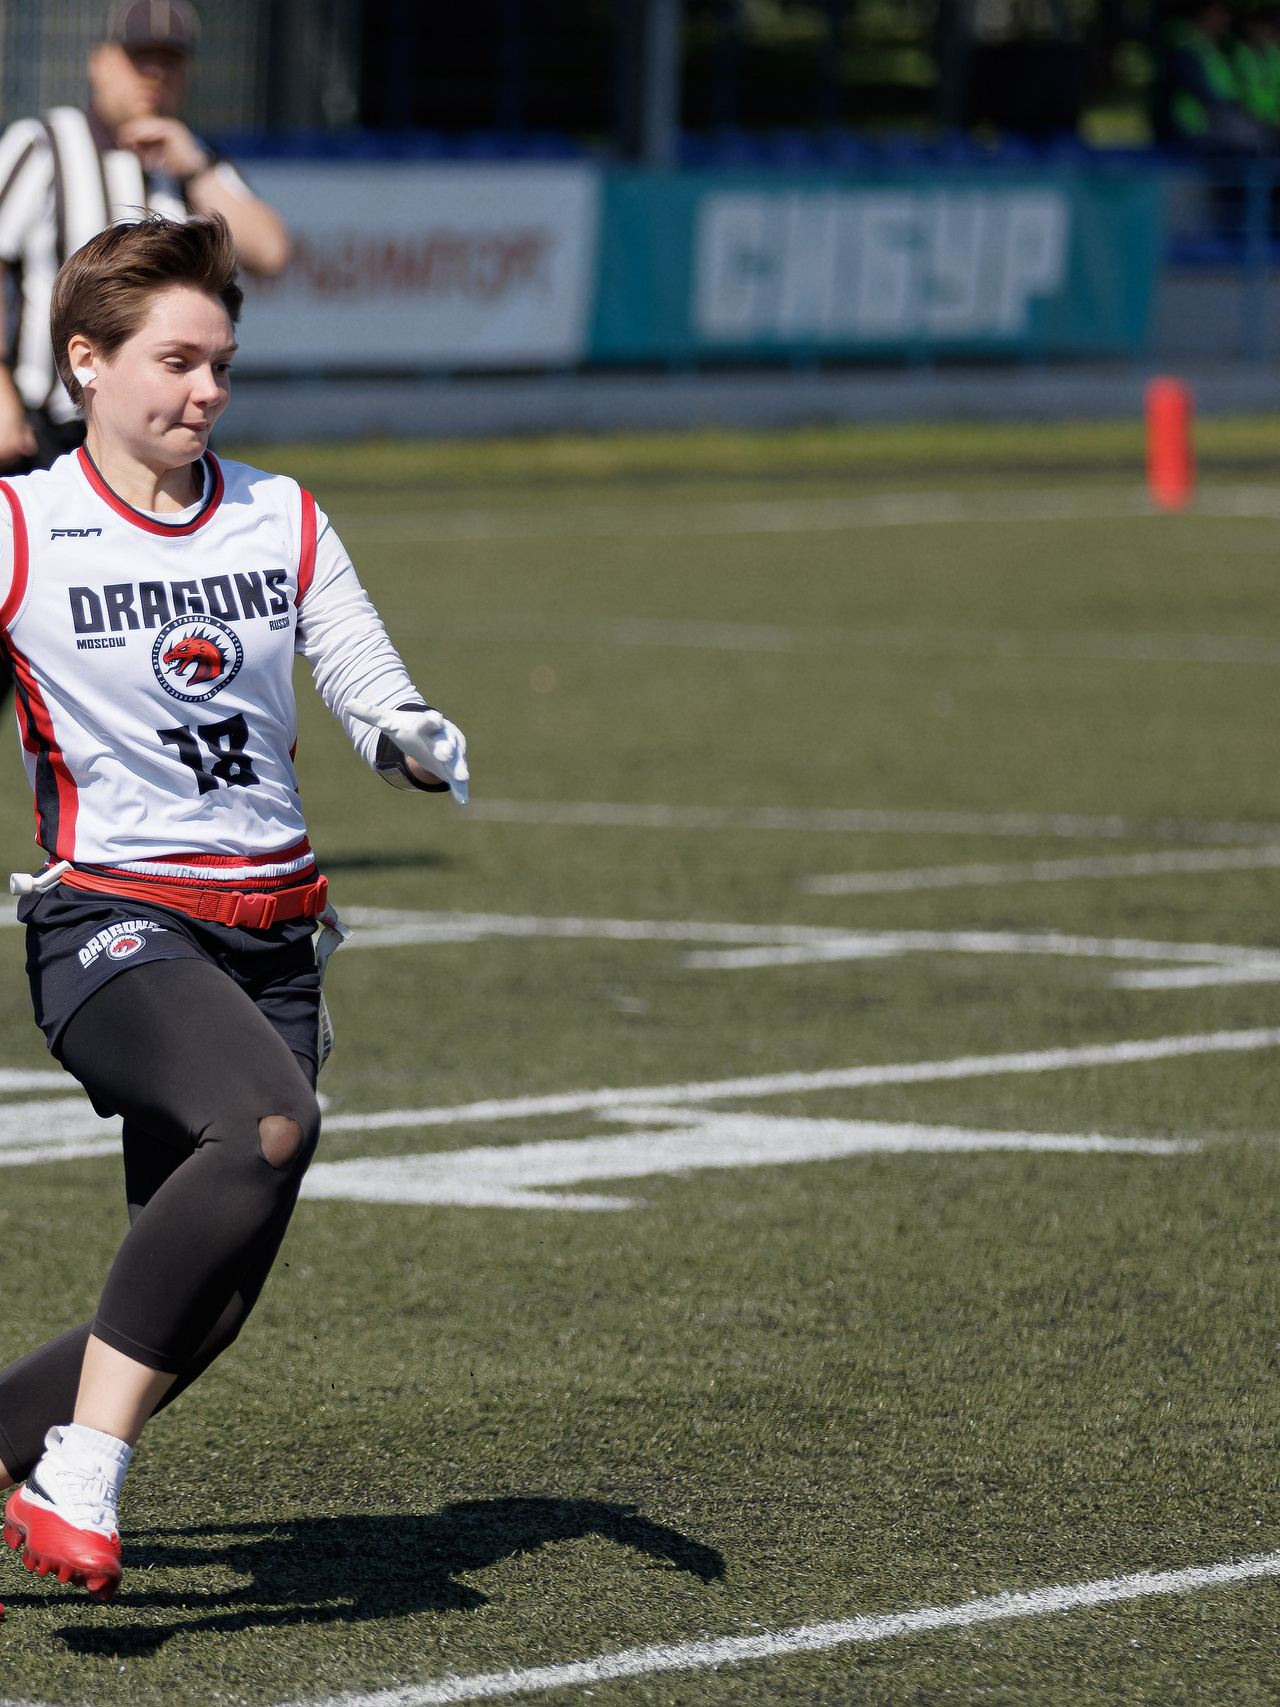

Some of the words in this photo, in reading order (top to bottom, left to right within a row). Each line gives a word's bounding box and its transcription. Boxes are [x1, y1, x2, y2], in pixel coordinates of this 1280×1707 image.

[694, 188, 1068, 341] СИБУР
[68, 568, 290, 634] DRAGONS
[76, 636, 126, 650] MOSCOW
[156, 713, 261, 796] 18
